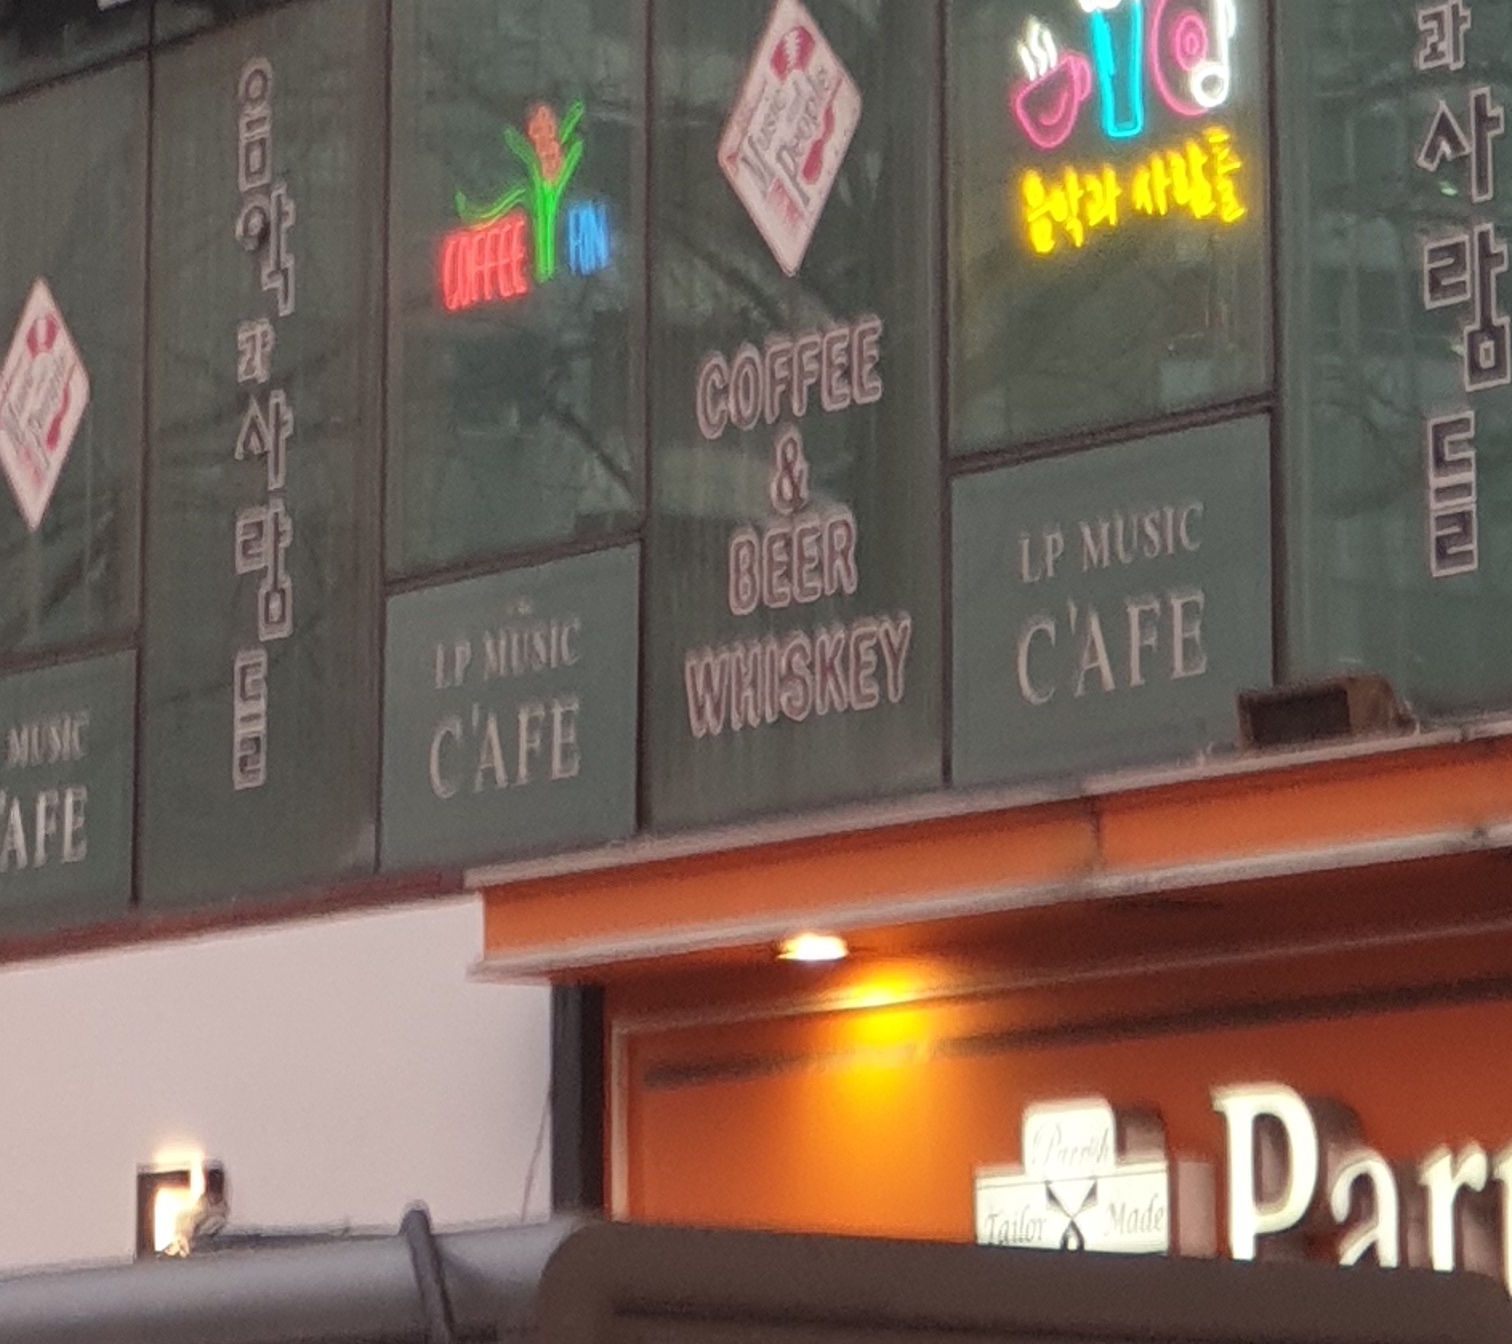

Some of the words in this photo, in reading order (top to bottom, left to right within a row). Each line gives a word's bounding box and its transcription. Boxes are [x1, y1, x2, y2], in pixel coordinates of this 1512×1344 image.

[442, 214, 528, 312] COFFEE
[696, 314, 884, 440] COFFEE
[771, 427, 810, 514] &
[728, 506, 860, 617] BEER
[1018, 530, 1066, 586] LP
[1081, 502, 1206, 572] MUSIC
[434, 642, 472, 692] LP
[482, 618, 584, 680] MUSIC
[685, 614, 914, 740] WHISKEY
[4, 712, 88, 768] MUSIC
[1104, 1196, 1165, 1238] Made
[1210, 1080, 1512, 1302] Par
